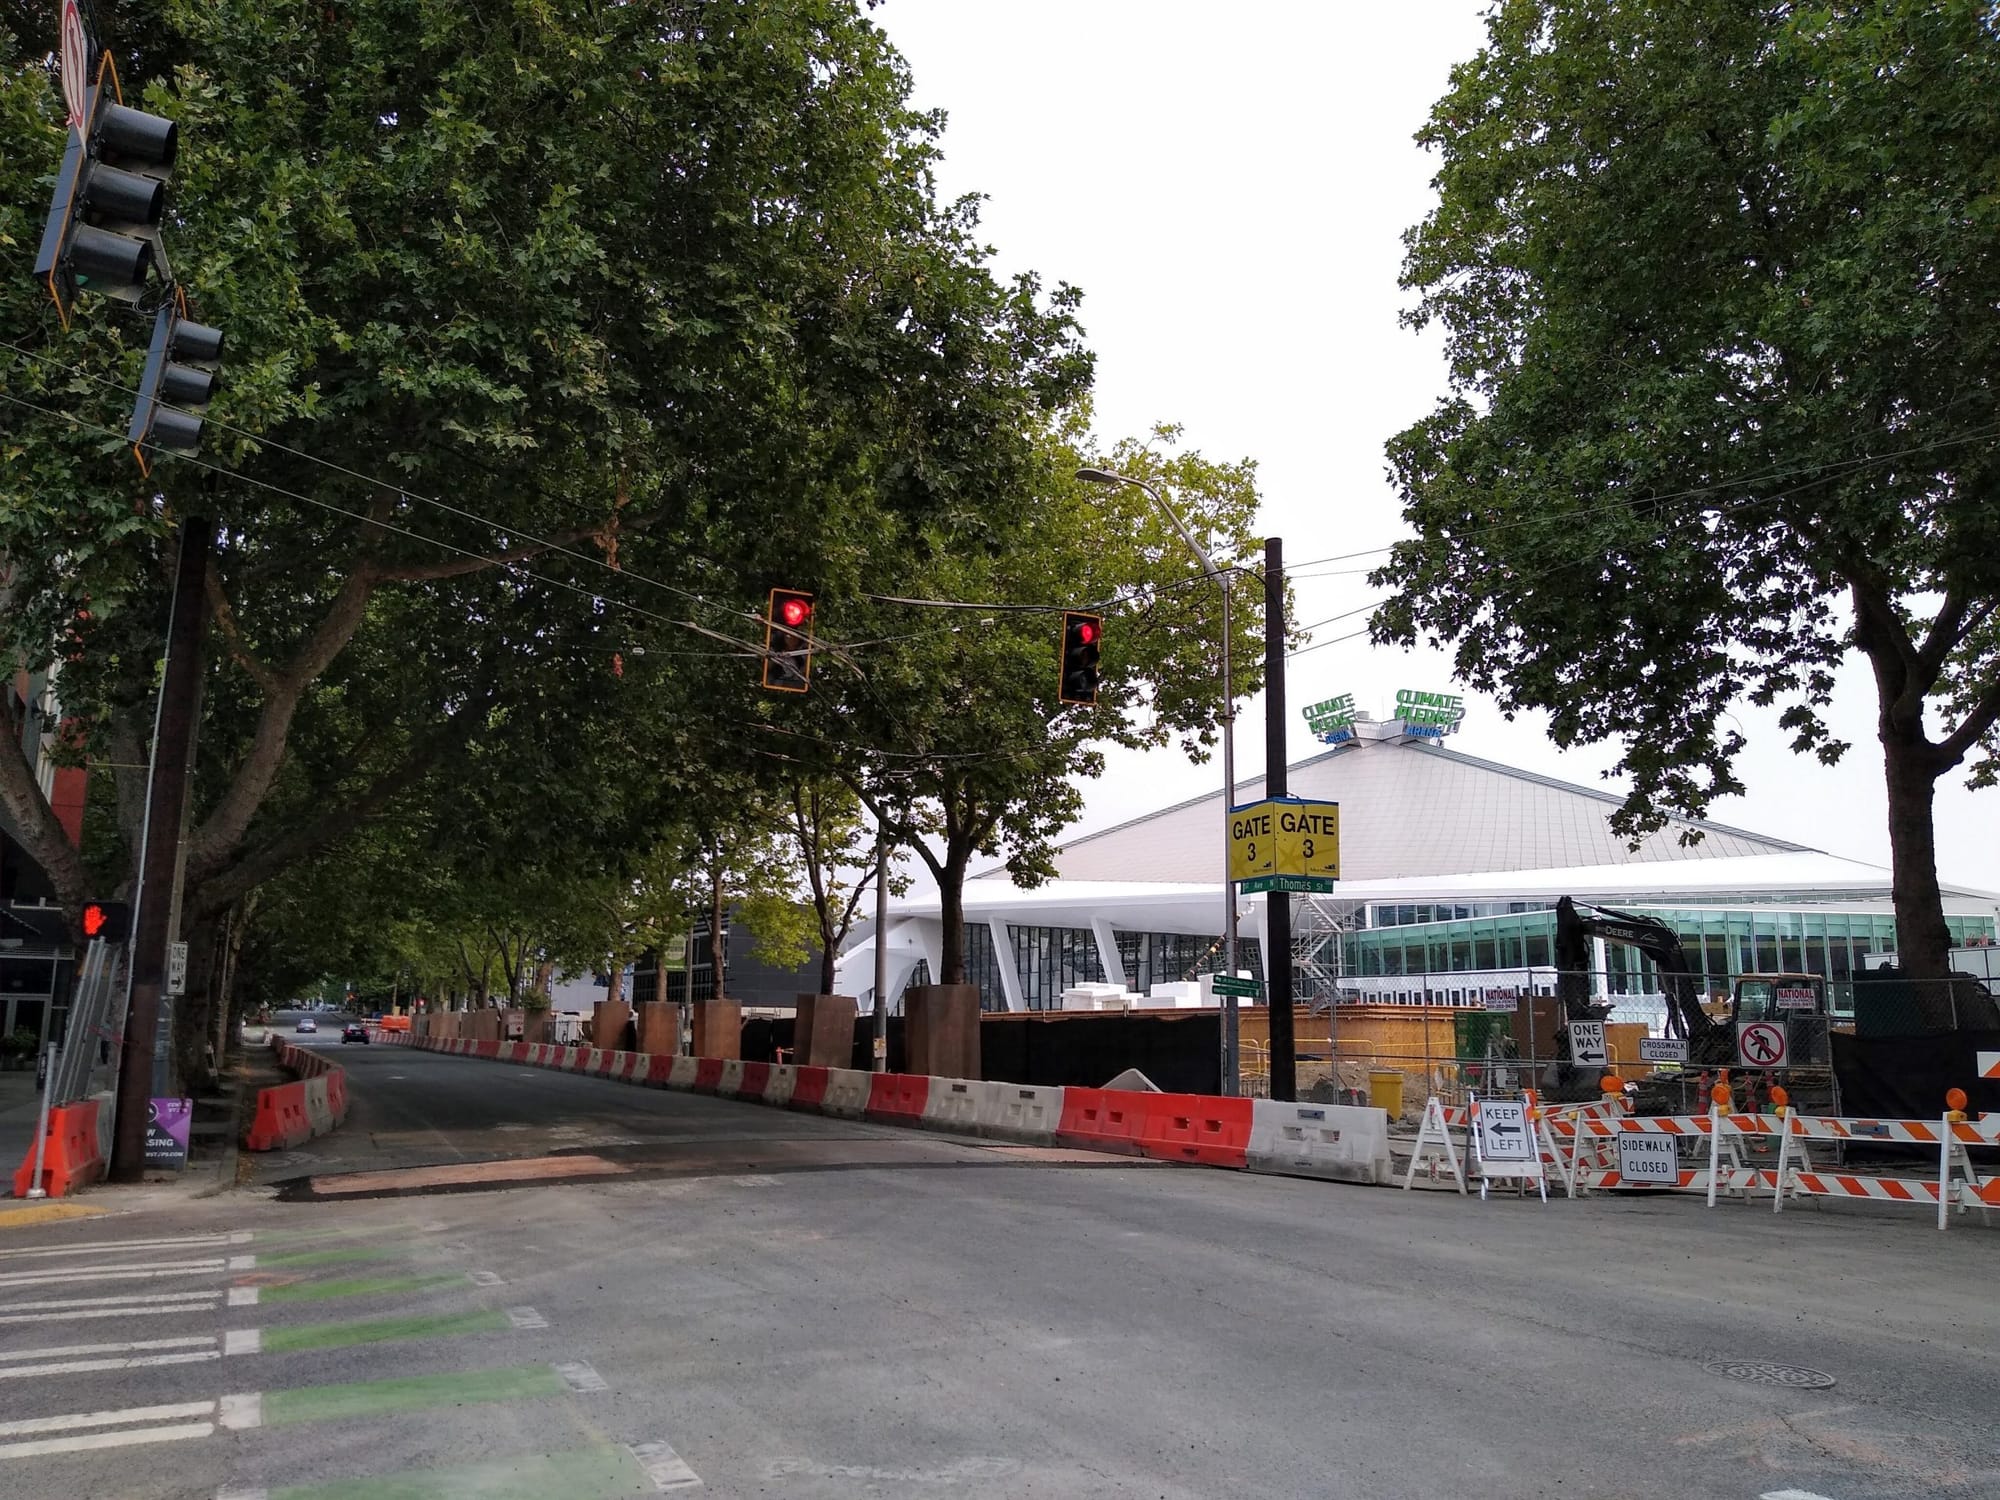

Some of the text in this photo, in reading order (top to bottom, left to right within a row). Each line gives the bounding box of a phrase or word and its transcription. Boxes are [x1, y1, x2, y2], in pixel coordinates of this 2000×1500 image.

[1396, 689, 1463, 710] CLIMATE
[1302, 693, 1356, 720] CLIMATE
[1395, 705, 1457, 725] PLEDGE
[1325, 729, 1355, 745] ARENA
[1405, 725, 1441, 737] ARENA
[1233, 815, 1271, 840] GATE
[1281, 812, 1335, 836] GATE
[1248, 843, 1256, 862] 3
[1303, 839, 1314, 859] 3
[1269, 879, 1275, 888] N
[1279, 877, 1312, 891] Thomas
[1316, 882, 1324, 890] St
[1605, 925, 1634, 939] DEERE
[172, 946, 186, 960] ONE
[171, 961, 185, 973] WAY
[1485, 988, 1516, 1000] NATIONAL
[1778, 989, 1814, 999] NATIONAL
[1573, 1024, 1600, 1036] ONE
[1575, 1037, 1602, 1049] WAY
[1641, 1041, 1686, 1050] CROSSWALK
[1485, 1108, 1519, 1120] KEEP
[1490, 1139, 1523, 1151] LEFT
[1622, 1139, 1673, 1152] SIDEWALK
[1629, 1160, 1668, 1173] CLOSED
